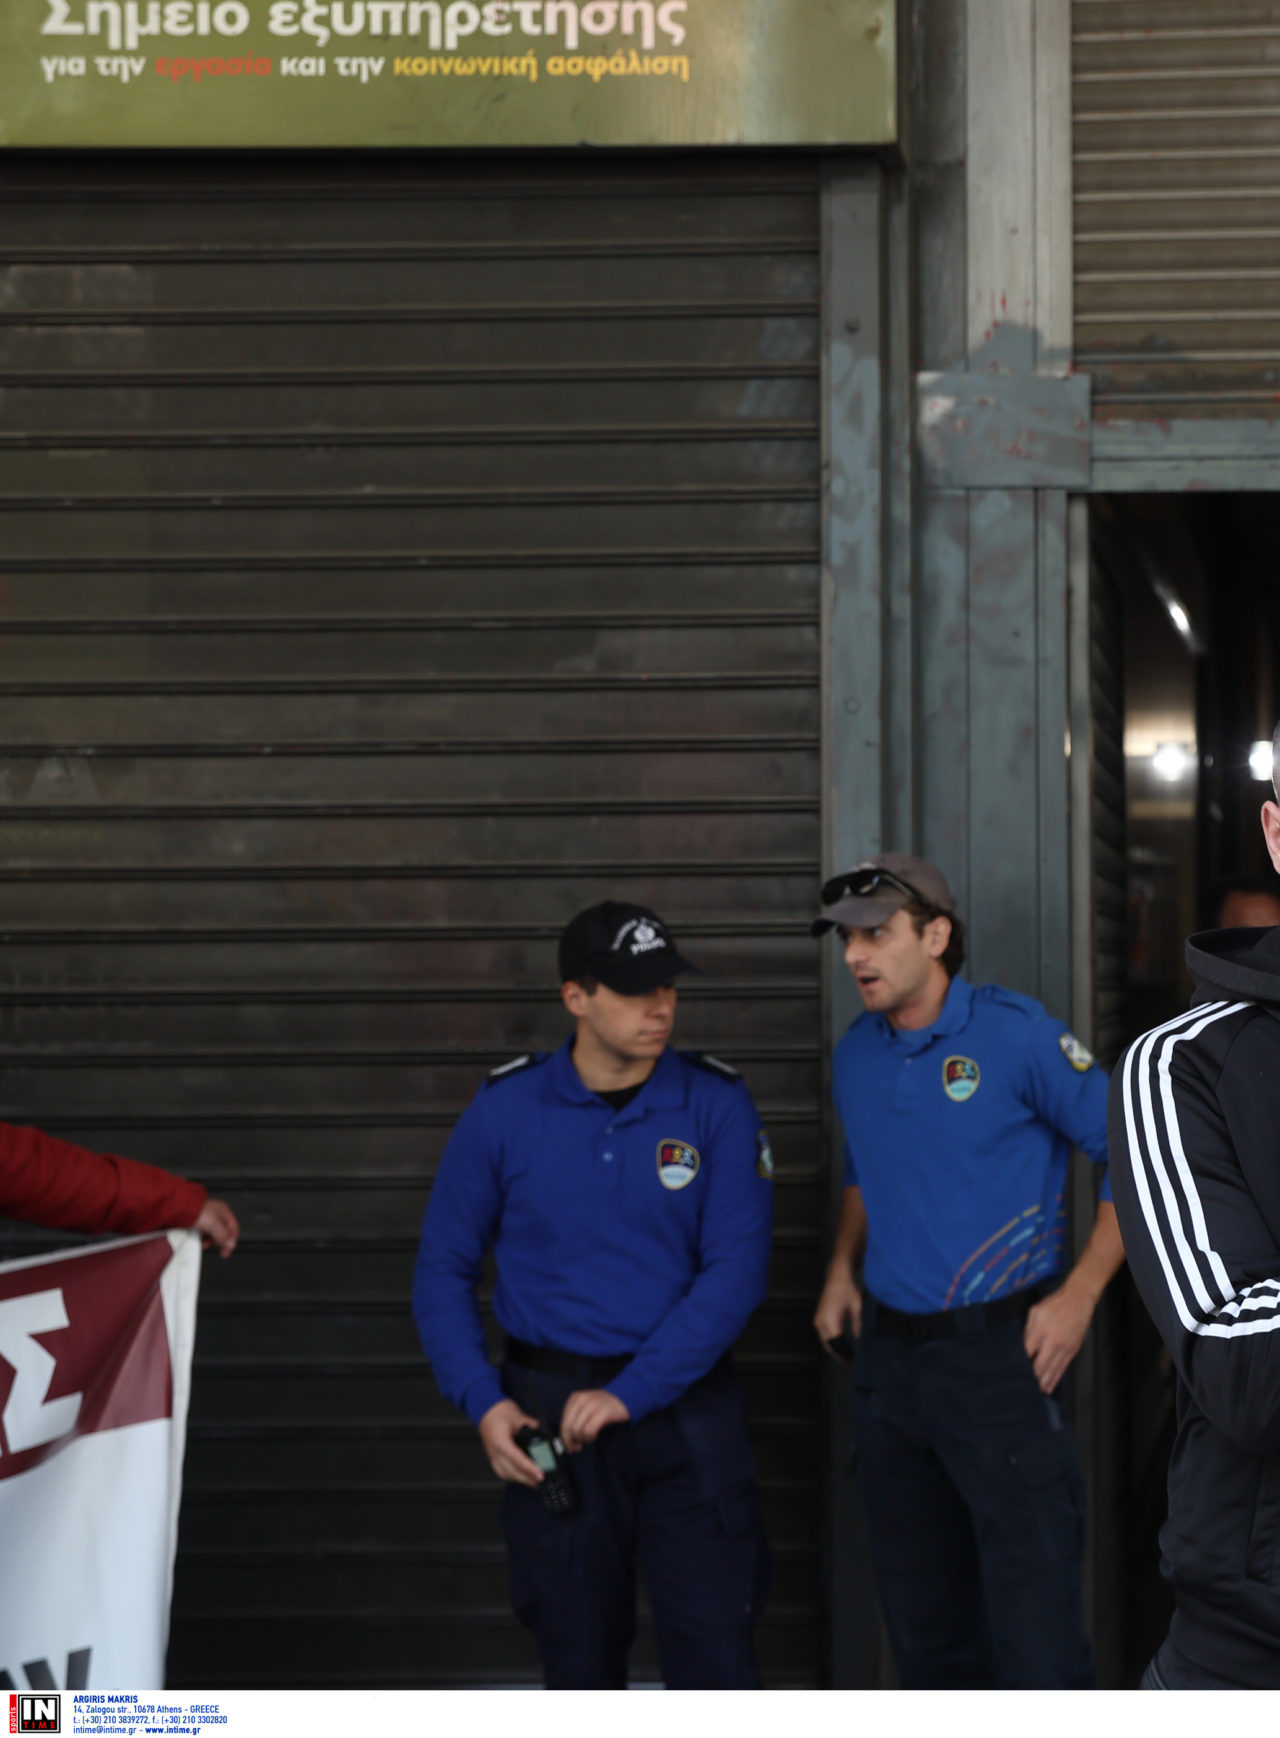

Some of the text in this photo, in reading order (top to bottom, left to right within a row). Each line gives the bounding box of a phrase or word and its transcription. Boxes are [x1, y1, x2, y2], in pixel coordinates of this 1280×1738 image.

[41, 49, 689, 84] για την εργασία και την κοινωνική ασφάλιση
